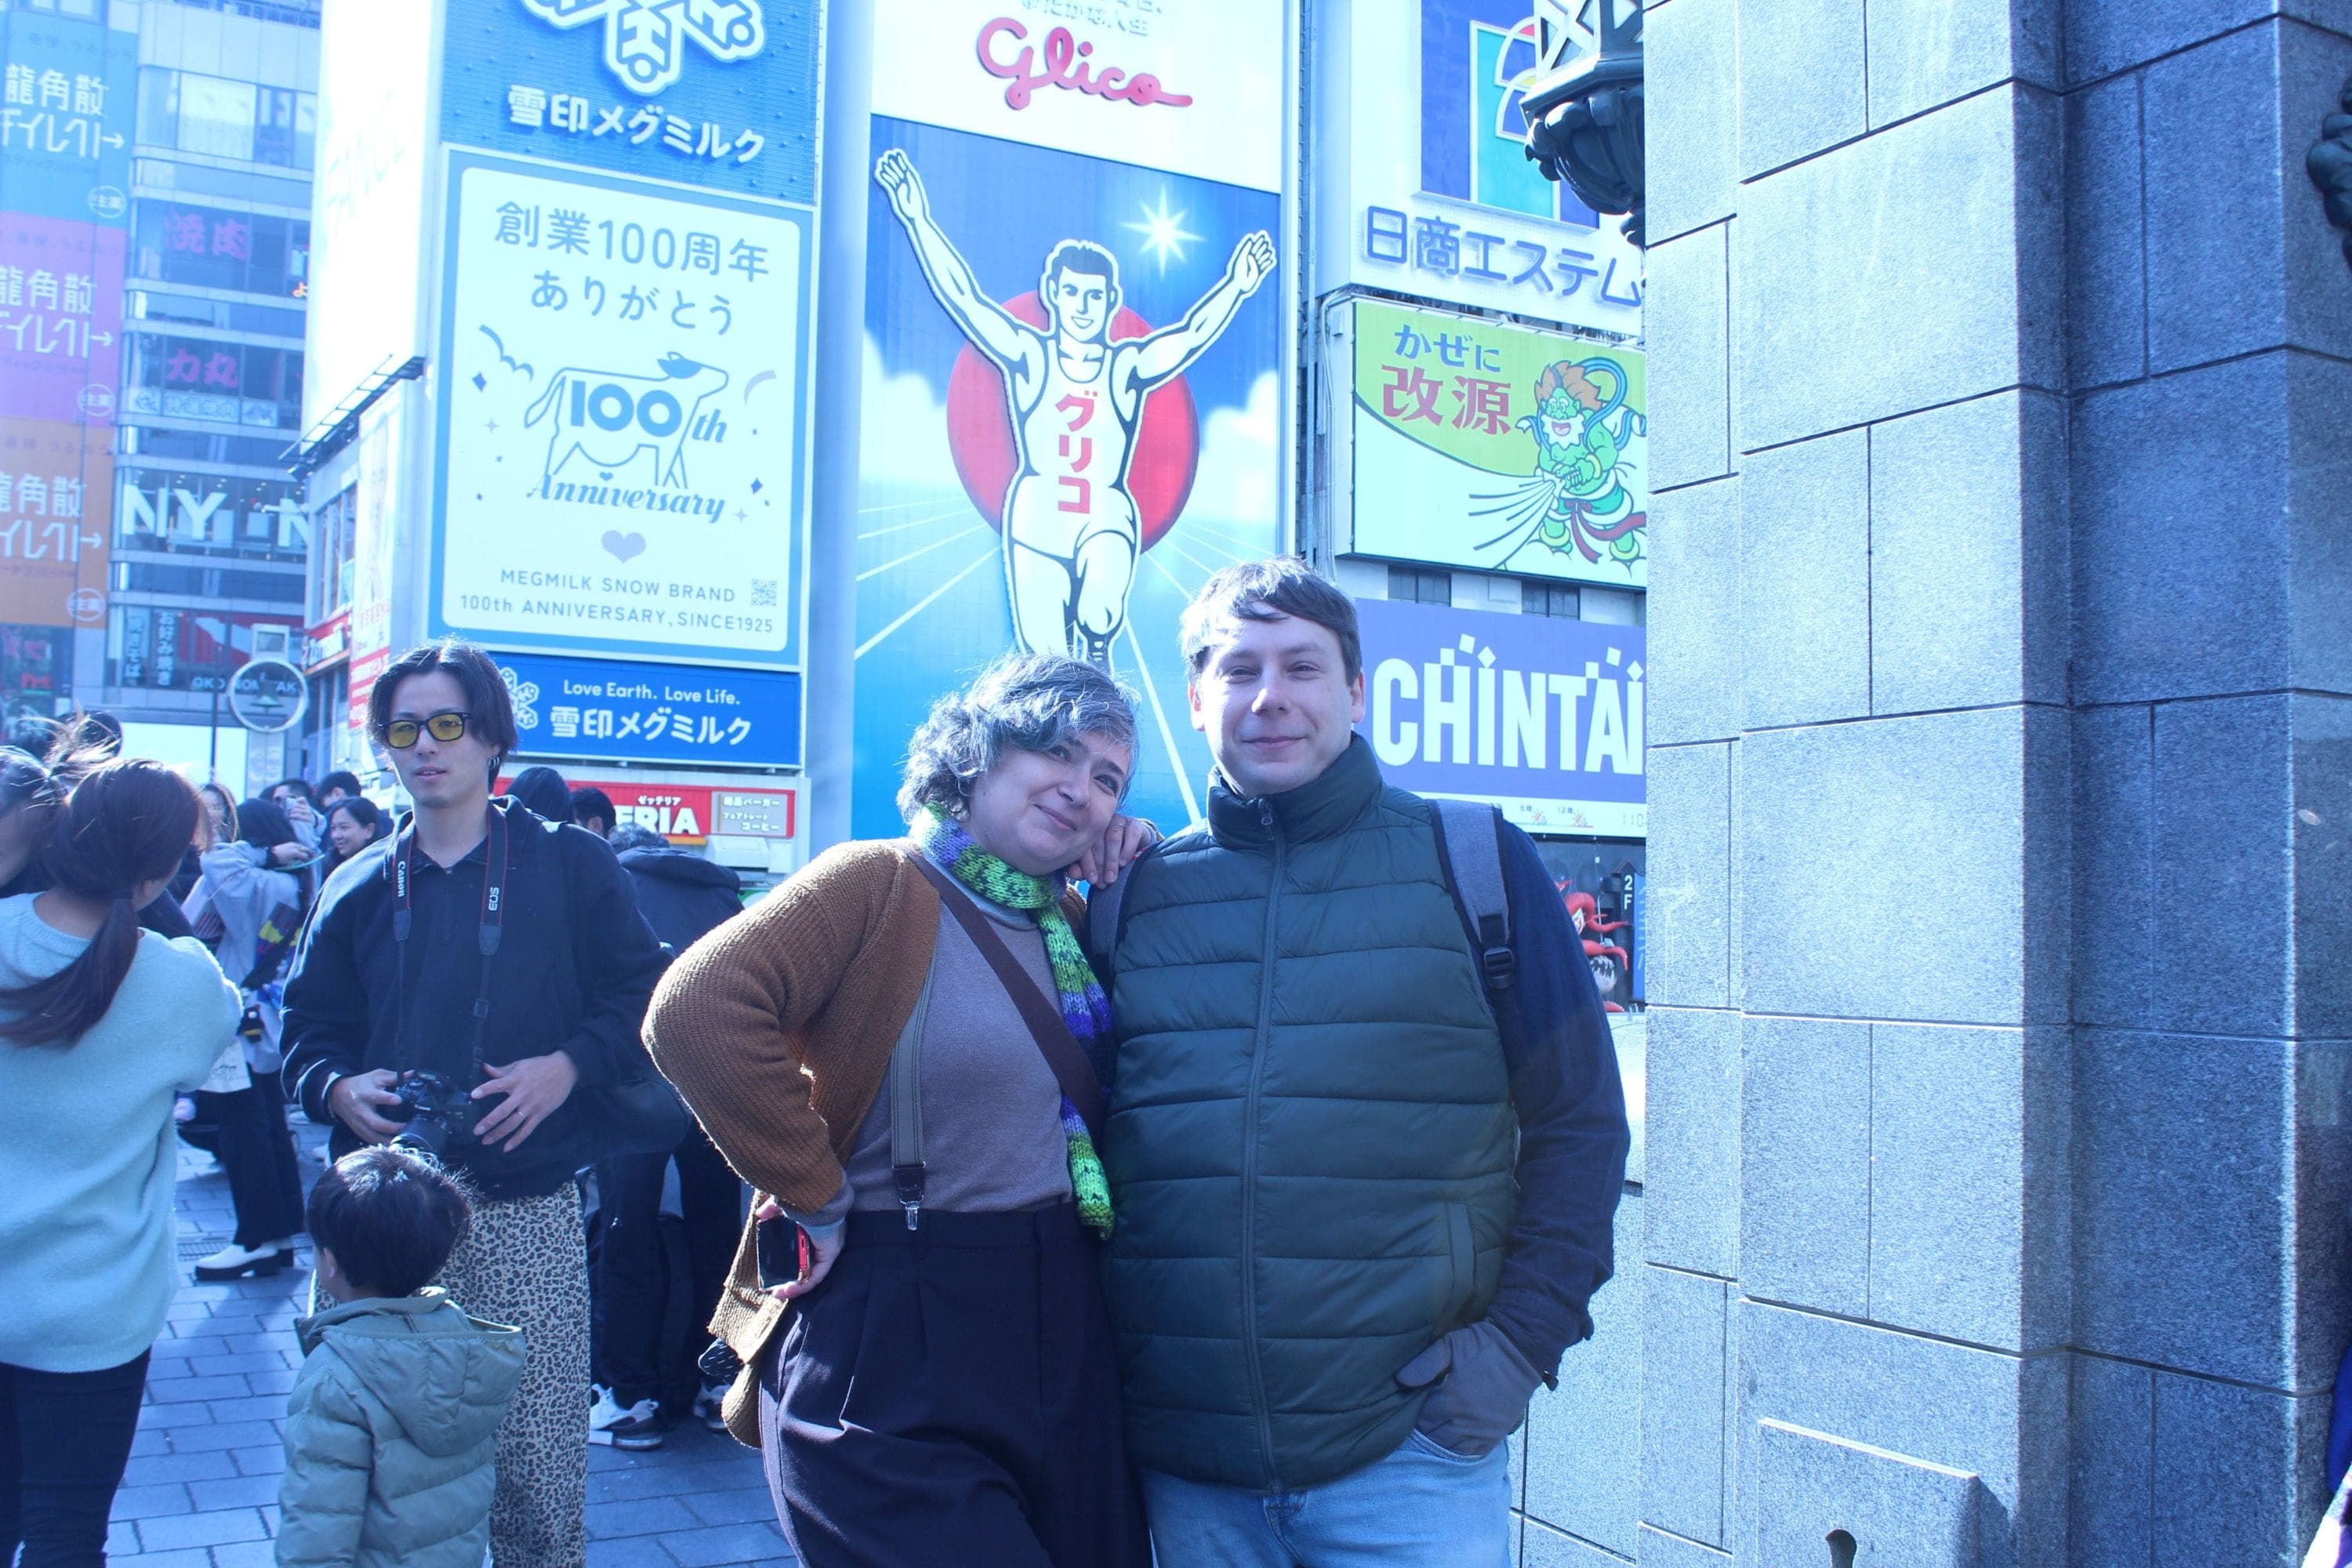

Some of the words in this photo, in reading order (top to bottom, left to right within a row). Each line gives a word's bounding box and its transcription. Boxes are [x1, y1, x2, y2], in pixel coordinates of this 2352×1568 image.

[976, 16, 1193, 110] Glico
[4, 63, 110, 118] 龍角散
[507, 84, 764, 163] 雪印メグミルク
[495, 200, 769, 283] 創業100周年
[1367, 205, 1642, 307] 日商エステム
[532, 270, 732, 336] ありがとう
[0, 311, 90, 360] イレクト
[1394, 325, 1501, 373] かぜに
[1381, 363, 1512, 435] 改源
[1055, 390, 1098, 514] グリコ
[526, 473, 725, 523] Anniversary
[460, 594, 512, 612] 100th
[501, 568, 592, 590] MEGMILK
[602, 577, 660, 596] SNOW
[670, 583, 735, 602] BRAND
[564, 679, 602, 695] Love
[607, 682, 658, 699] Earth.
[665, 686, 702, 702] Love
[706, 688, 741, 705] Life.
[1373, 633, 1644, 775] CHINTAI
[550, 706, 752, 745] 雪印メグミルク
[637, 795, 682, 806] ゼッテリア
[741, 822, 780, 832] コーヒー
[397, 861, 406, 898] Canon
[488, 887, 499, 911] EOS
